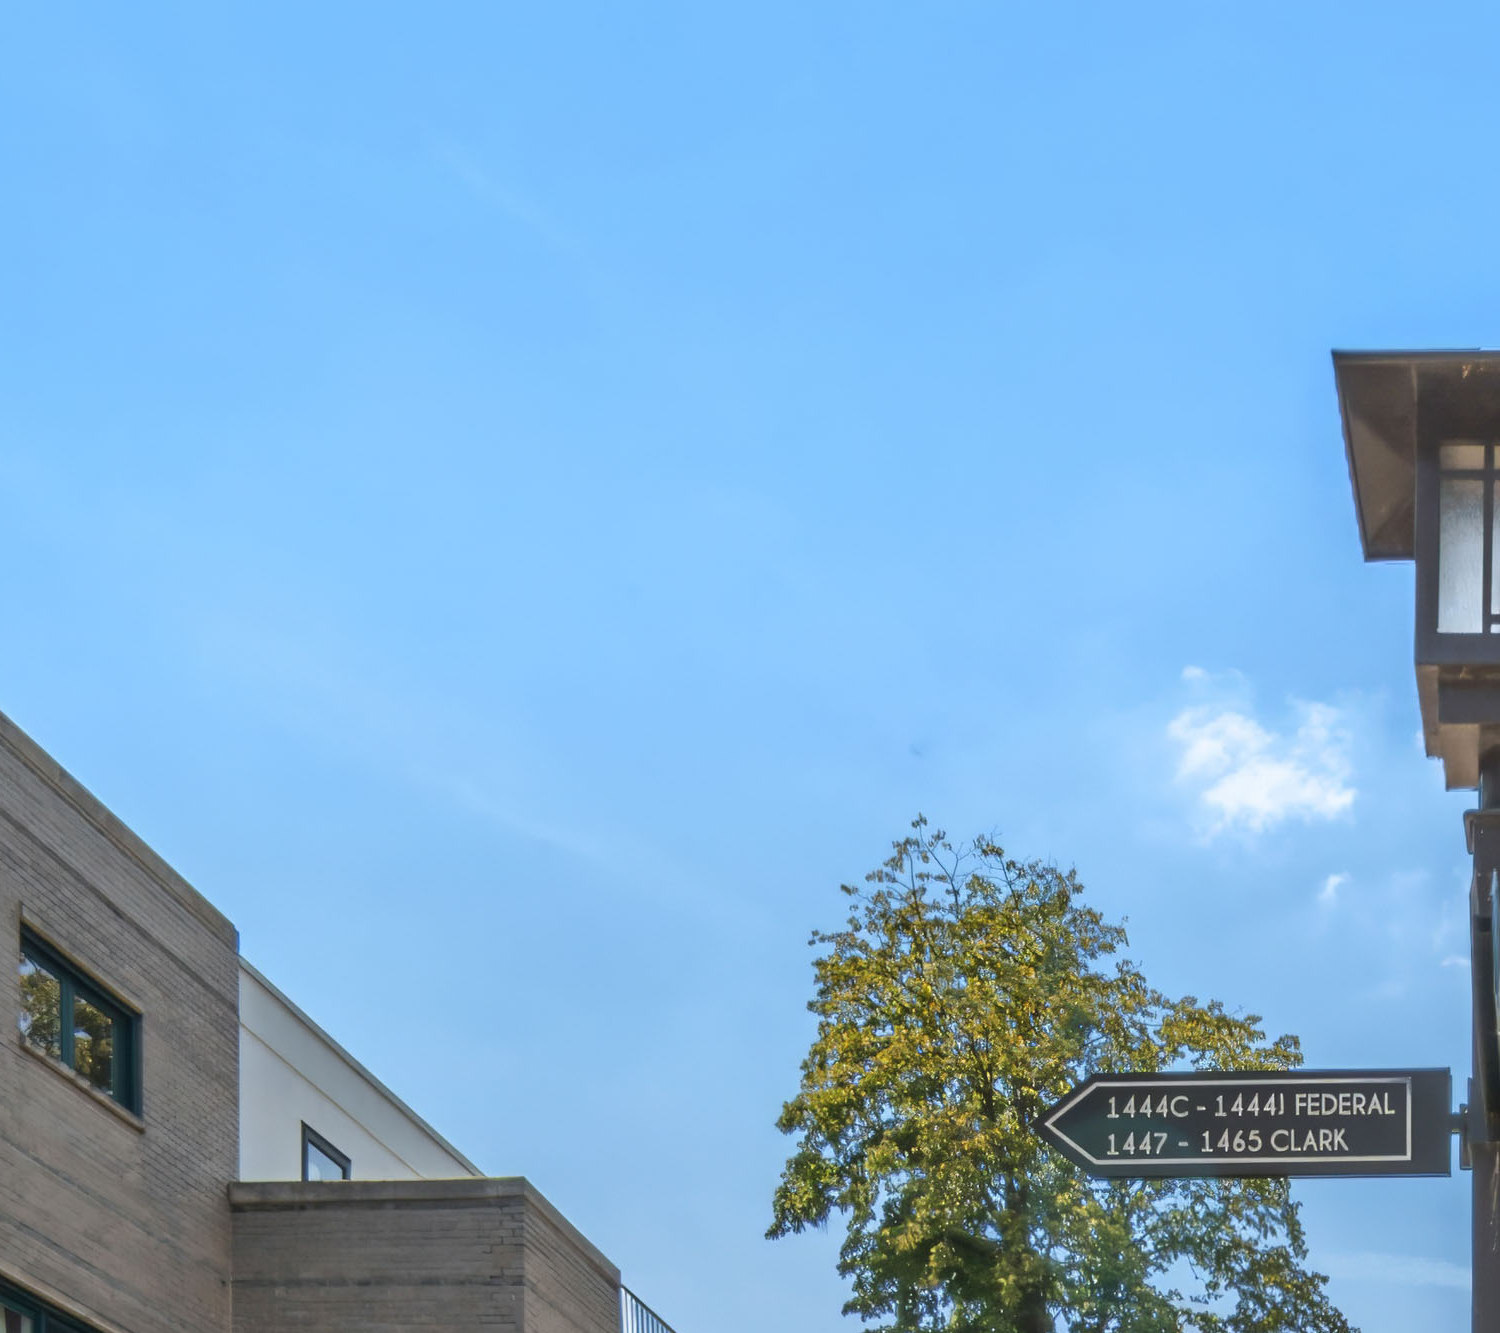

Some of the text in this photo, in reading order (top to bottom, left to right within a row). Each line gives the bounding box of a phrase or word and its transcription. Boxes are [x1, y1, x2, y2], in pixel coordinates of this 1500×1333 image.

[1107, 1094, 1189, 1118] 1444C
[1215, 1092, 1285, 1117] 1444J
[1295, 1092, 1396, 1116] FEDERAL
[1107, 1131, 1168, 1155] 1447
[1201, 1128, 1263, 1152] 1465
[1270, 1128, 1349, 1152] CLARK
